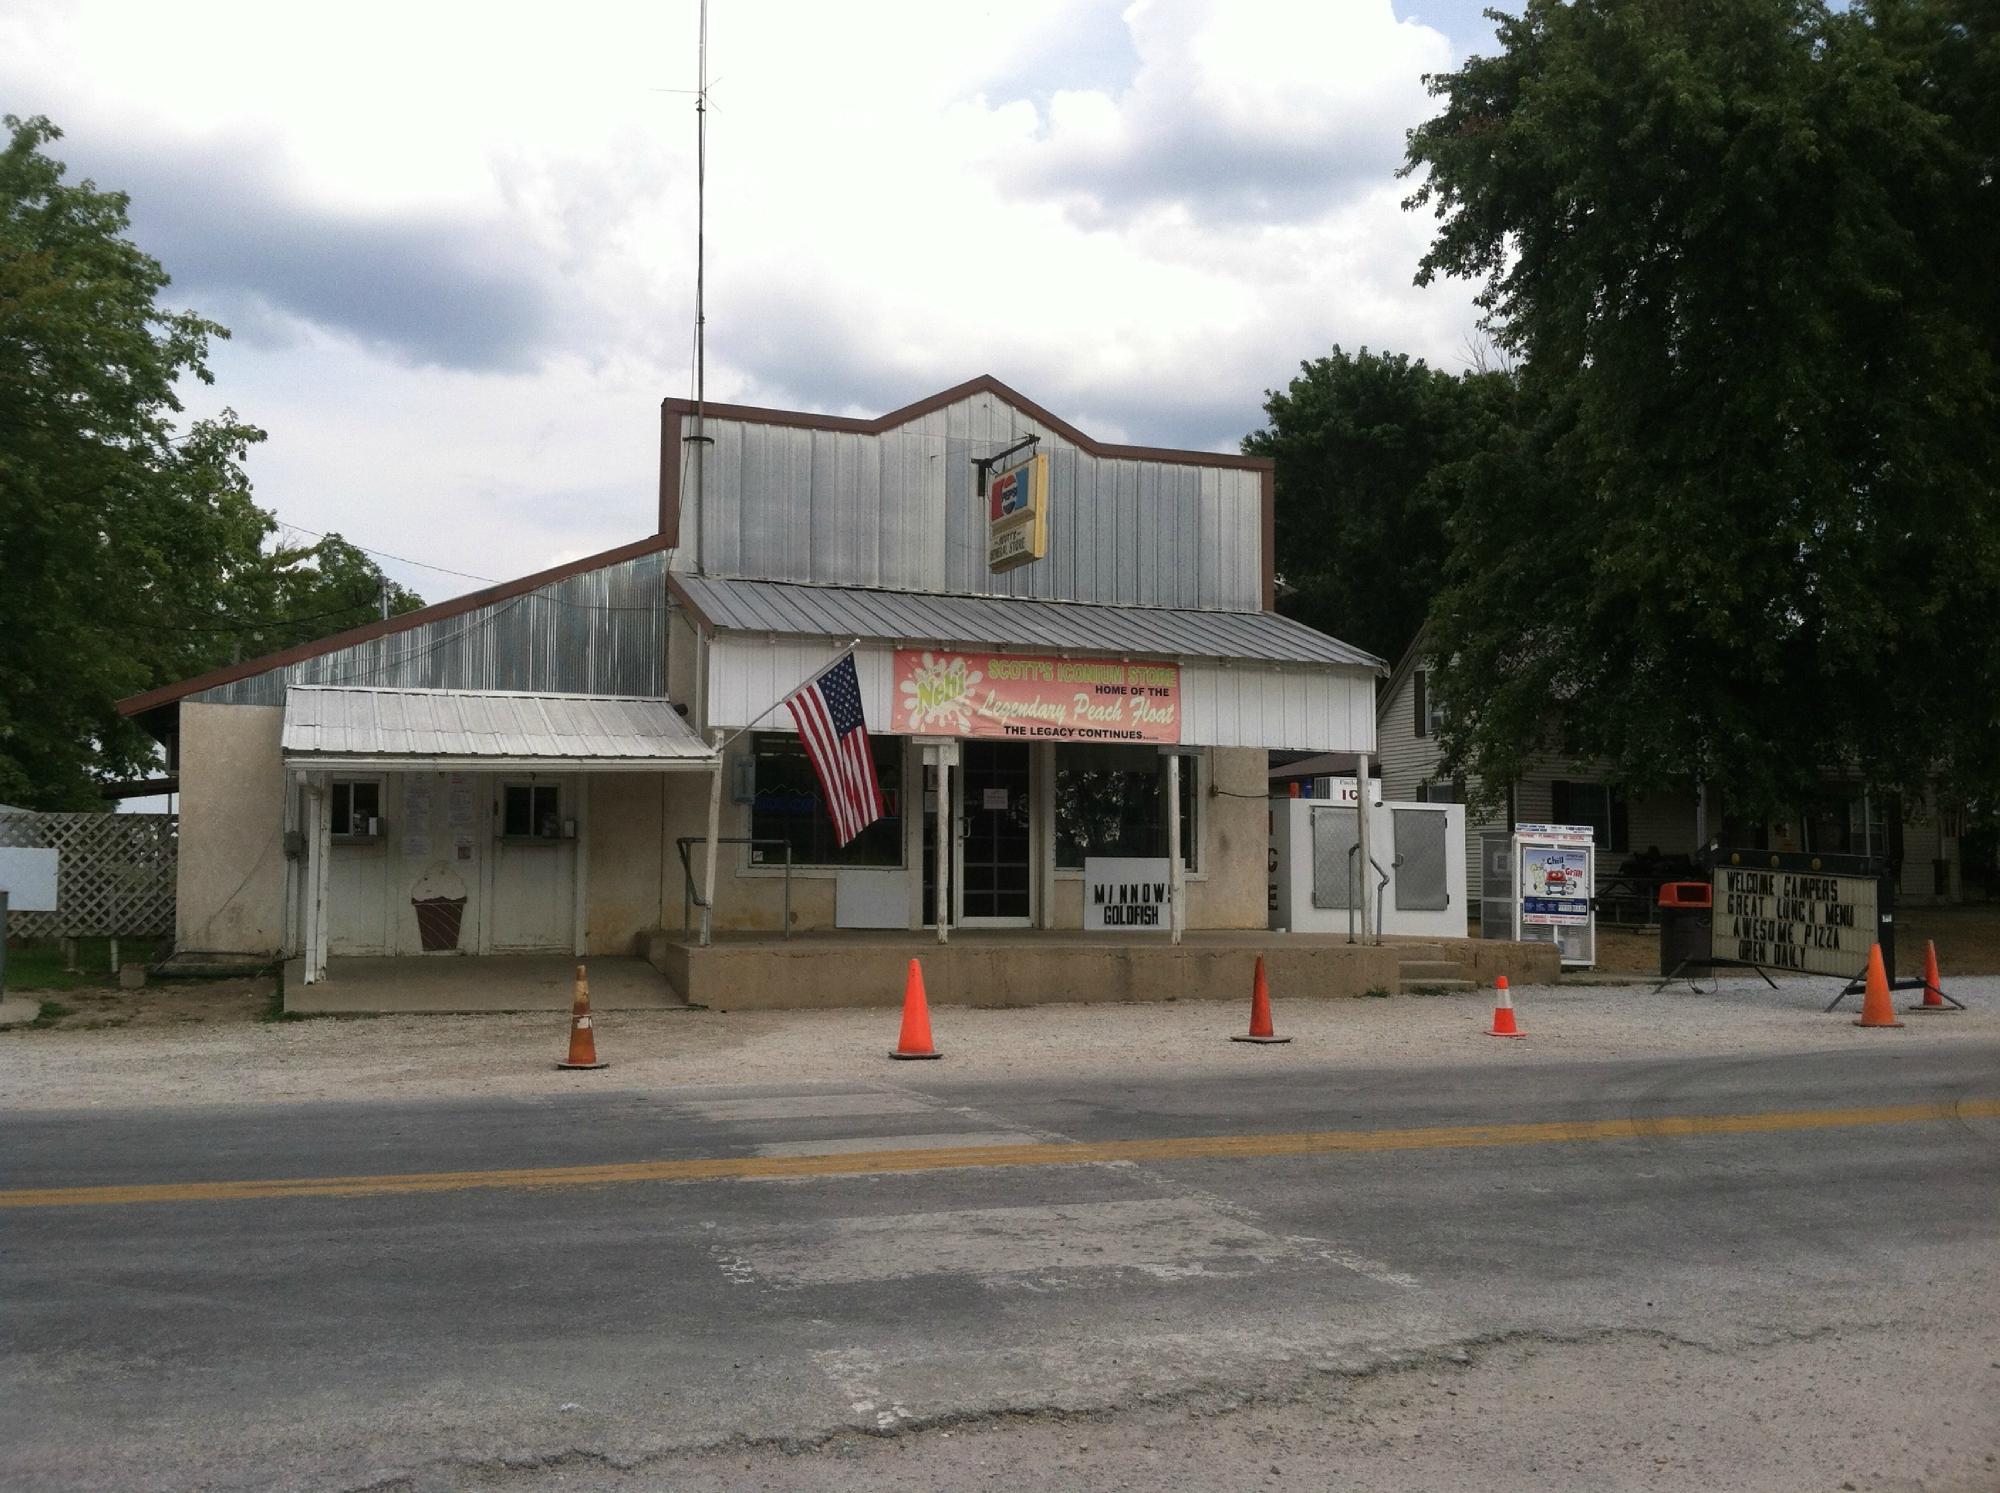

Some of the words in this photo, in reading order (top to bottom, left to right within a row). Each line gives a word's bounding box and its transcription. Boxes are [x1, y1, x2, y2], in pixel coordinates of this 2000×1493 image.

[987, 658, 1054, 682] SCOTT'S
[1057, 662, 1124, 684] ICONIUM
[1128, 665, 1177, 688] STORE
[1095, 685, 1128, 696] HOME
[1130, 687, 1146, 696] OF
[1148, 688, 1170, 697] THE
[976, 689, 1067, 724] Legendary
[1073, 693, 1122, 722] Peach
[1129, 696, 1175, 727] Float
[1003, 725, 1027, 736] THE
[1030, 726, 1075, 738] LEGACY
[1342, 789, 1370, 801] IC
[1094, 883, 1171, 904] MINNOW
[1727, 871, 1774, 896] WELCOME
[1784, 875, 1838, 901] CAMPERS
[1103, 905, 1159, 925] GOLDFISH
[1727, 894, 1764, 917] GREAT
[1777, 898, 1815, 923] LUNCH
[1825, 903, 1854, 927] MENU
[1733, 916, 1793, 944] AWESOME
[1804, 924, 1839, 949] PIZZA
[1738, 940, 1766, 962] OPEN
[1774, 943, 1805, 968] DAILY
